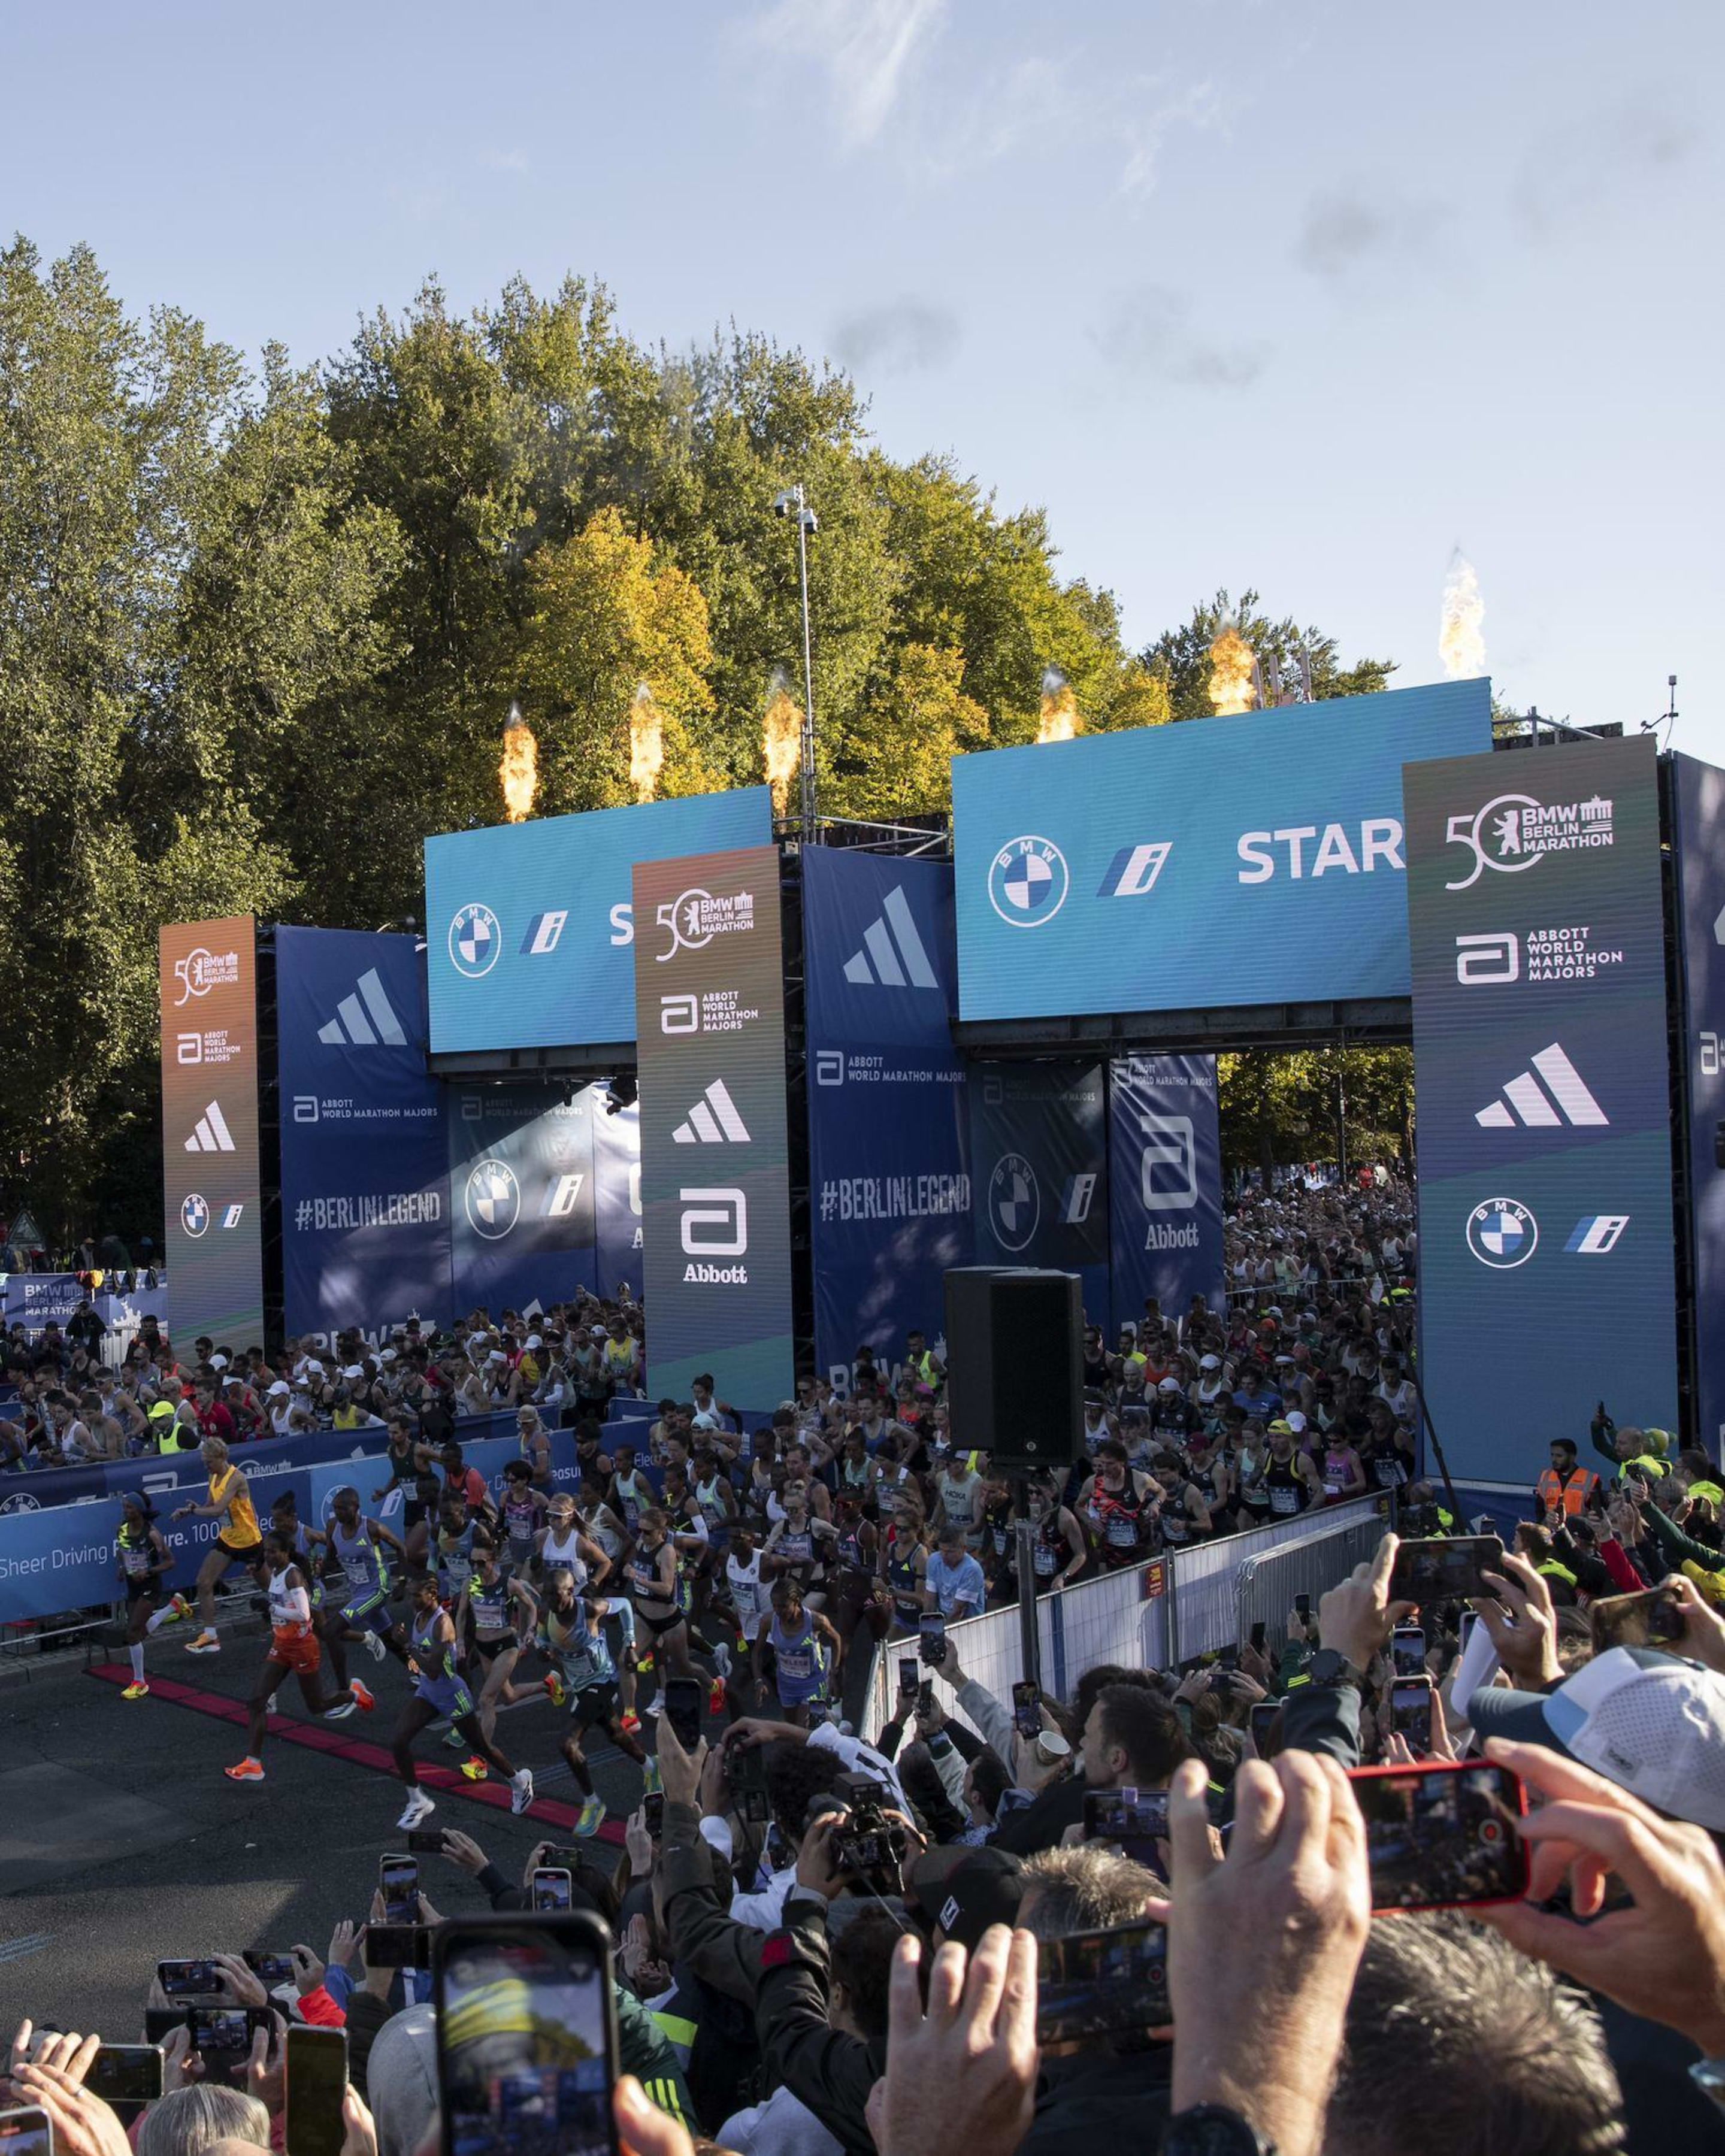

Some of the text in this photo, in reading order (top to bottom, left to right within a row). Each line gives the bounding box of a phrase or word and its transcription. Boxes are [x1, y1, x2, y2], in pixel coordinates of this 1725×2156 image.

[1522, 804, 1578, 826] BMW
[1523, 822, 1579, 838] BERLIN
[1523, 833, 1613, 853] MARATHON
[997, 841, 1056, 868] BMW
[701, 897, 733, 913] BMW
[455, 907, 493, 928] BMW
[701, 911, 734, 923] BERLIN
[701, 919, 753, 934] MARATHON
[1527, 927, 1589, 943] ABBOTT
[1527, 941, 1584, 954] WORLD
[204, 956, 225, 967] BMW
[1529, 951, 1623, 968] MARATHON
[204, 967, 225, 976] BERLIN
[1529, 965, 1596, 981] MAJORS
[204, 974, 238, 984] MARATHON
[703, 991, 739, 1002] ABBOTT
[703, 1001, 736, 1011] WORLD
[703, 1010, 758, 1022] MARATHON
[703, 1020, 742, 1031] MAJORS
[204, 1031, 228, 1039] ABBOTT
[205, 1038, 226, 1046] WORLD
[205, 1046, 240, 1055] MARATHON
[205, 1054, 231, 1063] MAJORS
[848, 1056, 883, 1067] ABBOTT
[848, 1070, 879, 1081] WORLD
[883, 1071, 932, 1082] MARATHON
[322, 1099, 353, 1108] ABBOTT
[322, 1108, 438, 1119] WORLD MARATHON MAJORS
[473, 1163, 512, 1186] BMW
[994, 1158, 1032, 1185] BMW
[820, 1174, 970, 1221] #BERLINLEGEND
[295, 1192, 441, 1231] #BERLINLEGEND
[1475, 1202, 1527, 1221] BMW
[1145, 1222, 1198, 1250] Abbott
[683, 1264, 748, 1284] Abbott
[25, 1285, 60, 1297] BMW
[25, 1297, 63, 1306] BERLIN
[25, 1306, 77, 1316] MARATHO
[0, 1555, 46, 1580] Sheer
[52, 1544, 108, 1570] Driving
